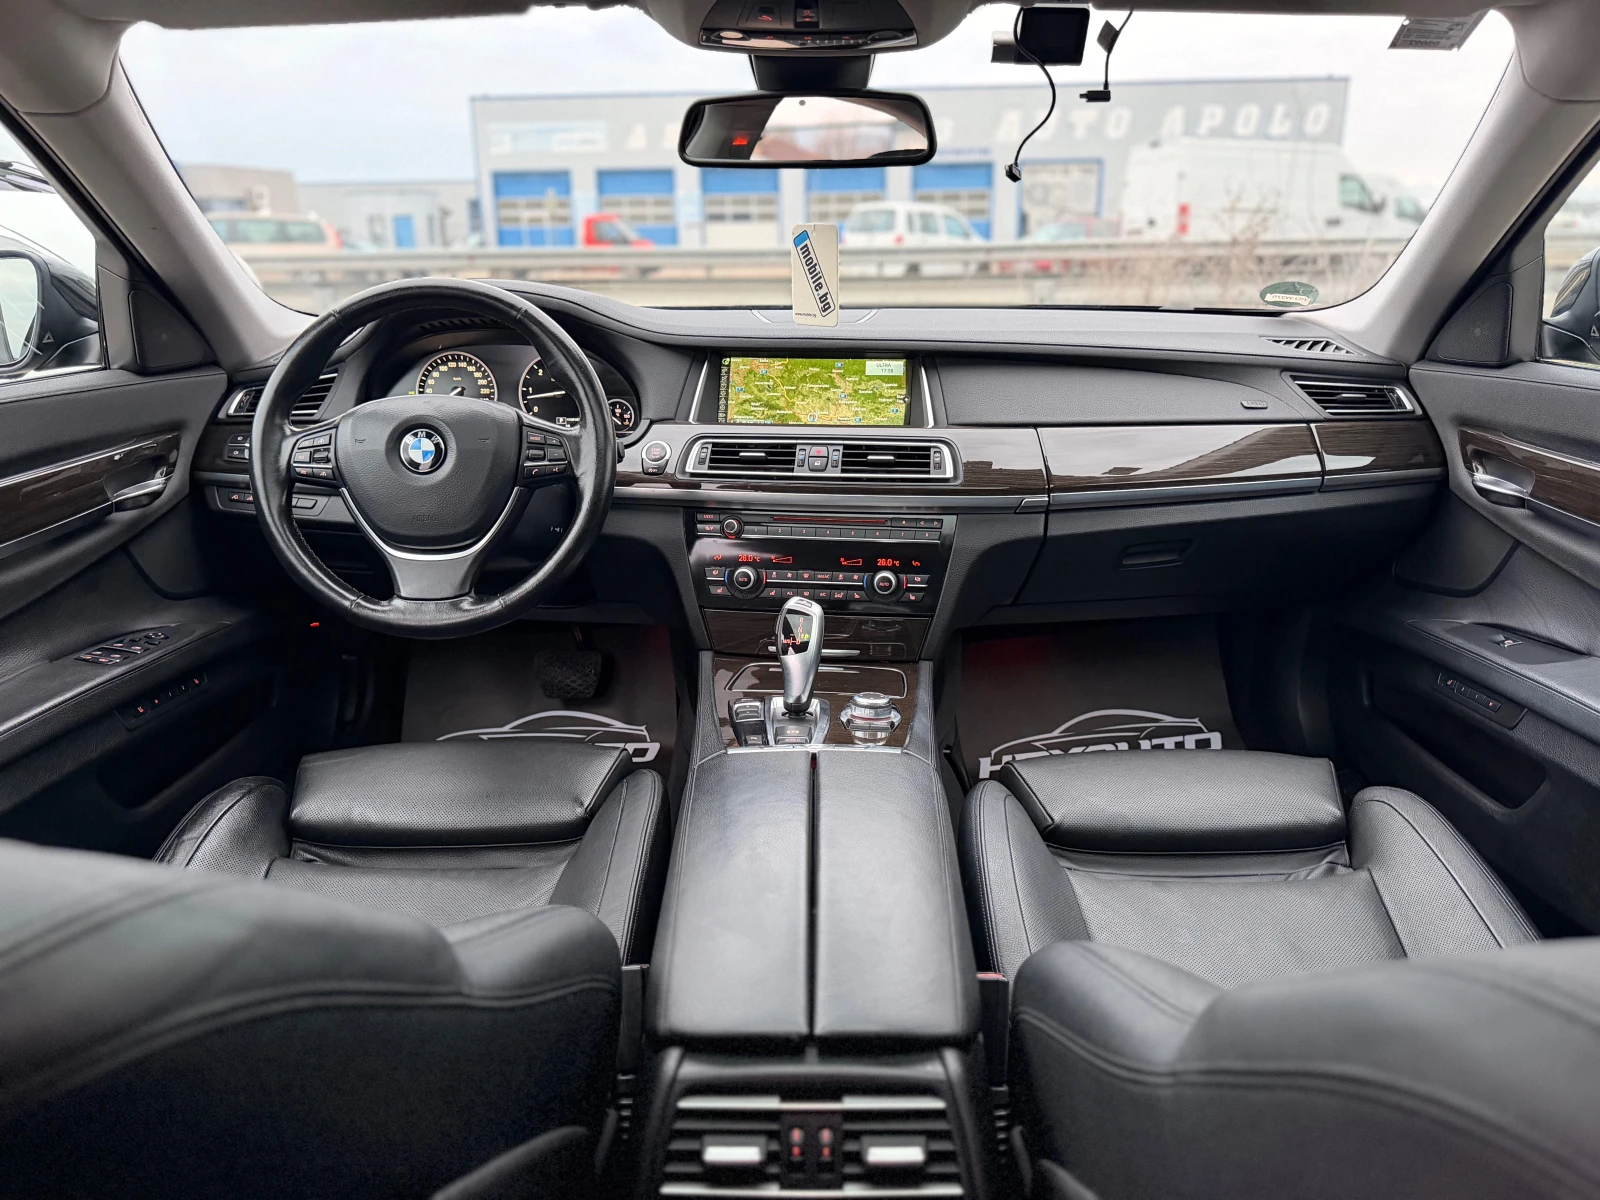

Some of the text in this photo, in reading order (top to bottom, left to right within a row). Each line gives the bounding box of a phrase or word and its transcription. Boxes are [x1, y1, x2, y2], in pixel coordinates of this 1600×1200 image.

[1161, 102, 1332, 139] APOLO
[800, 243, 832, 313] mobile.bg
[533, 405, 539, 413] 0
[405, 431, 440, 445] BMW
